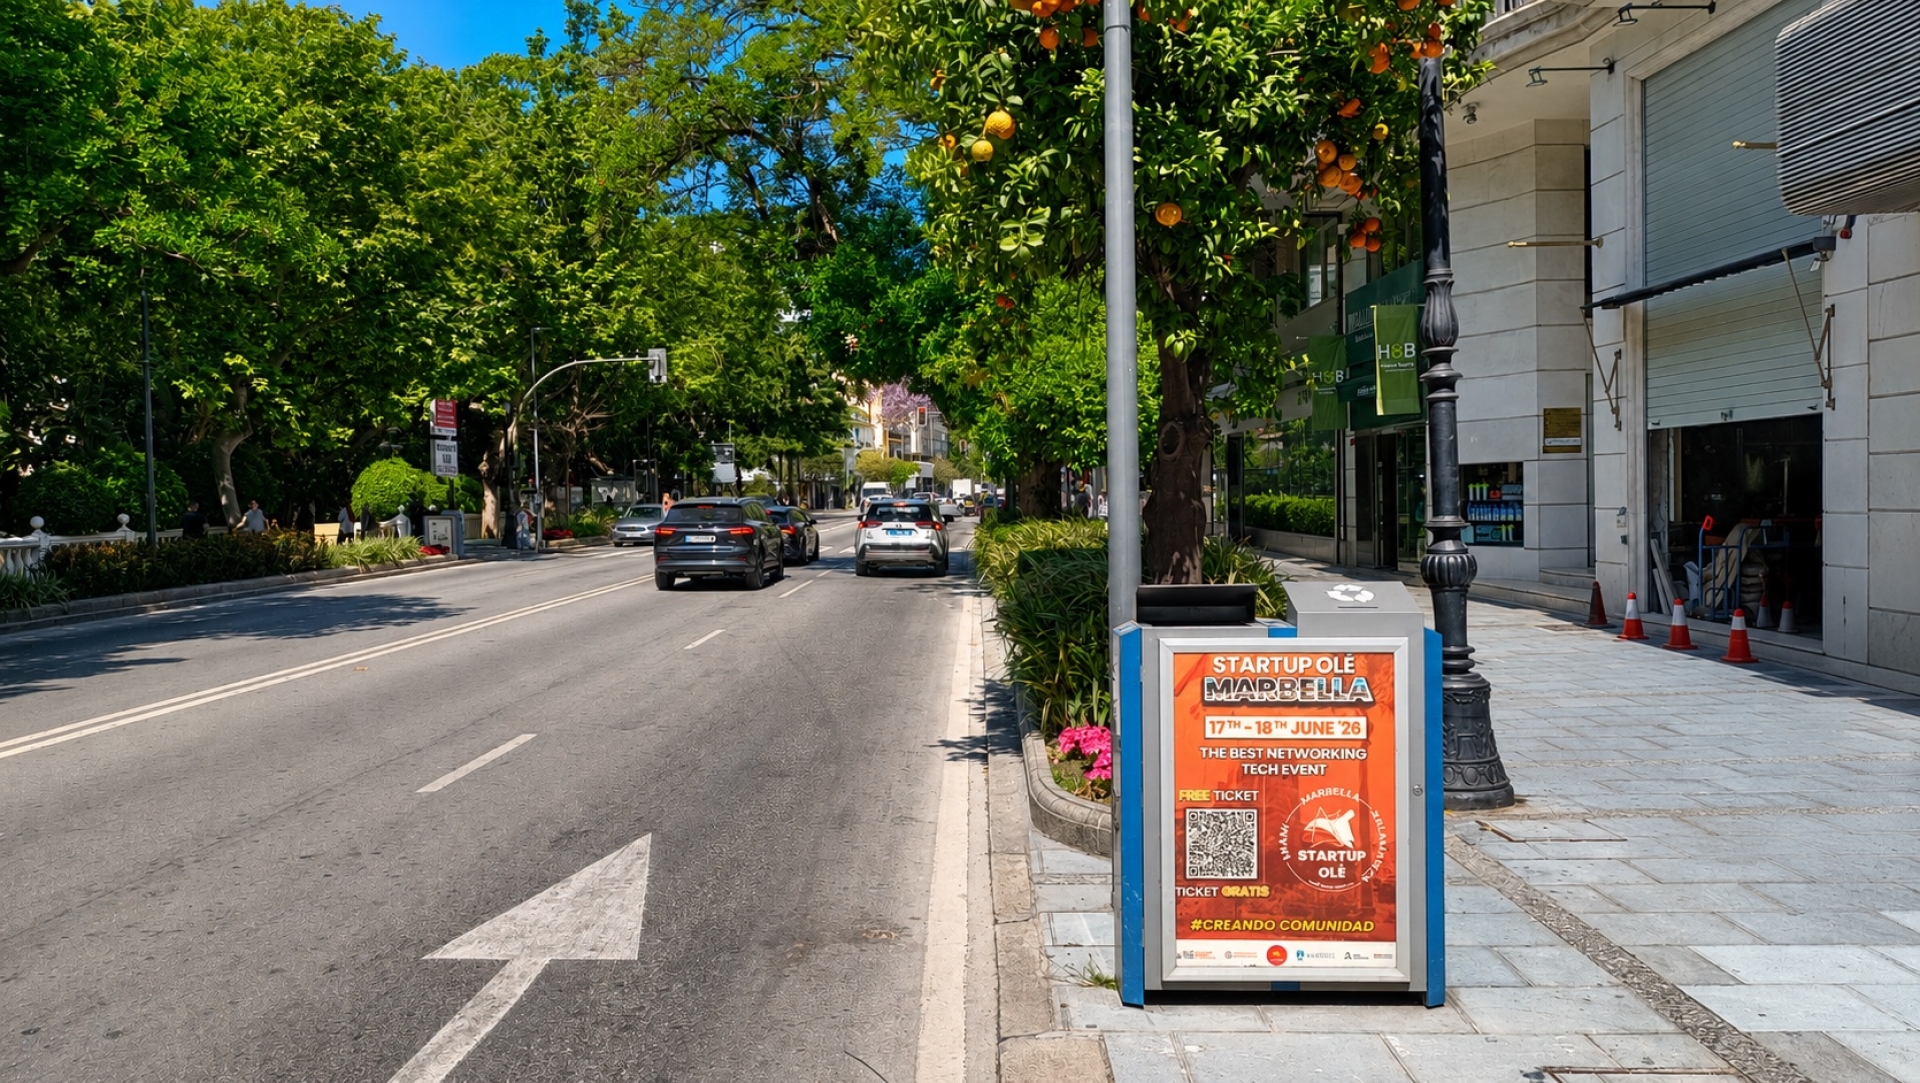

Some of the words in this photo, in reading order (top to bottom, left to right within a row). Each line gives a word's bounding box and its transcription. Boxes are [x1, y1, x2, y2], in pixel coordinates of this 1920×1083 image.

[1212, 656, 1313, 674] STARTUP
[1315, 653, 1355, 674] OLÉ
[1203, 676, 1375, 704] MARBELLA
[1208, 720, 1242, 735] 17TH
[1255, 720, 1288, 735] 18TH
[1290, 720, 1335, 735] JUNE
[1199, 747, 1228, 759] THE
[1229, 747, 1264, 759] BEST
[1266, 747, 1368, 760] NETWORKING
[1241, 763, 1279, 775] TECH
[1281, 763, 1328, 776] EVENT
[1179, 789, 1211, 801] FREE
[1213, 790, 1260, 801] TICKET
[1297, 850, 1367, 862] STARTUP
[1318, 863, 1346, 878] OLÉ
[1175, 886, 1219, 897] TICKET
[1221, 885, 1270, 898] GRATIS
[1190, 918, 1276, 931] #CREANDO
[1279, 919, 1375, 932] COMUNIDAD
